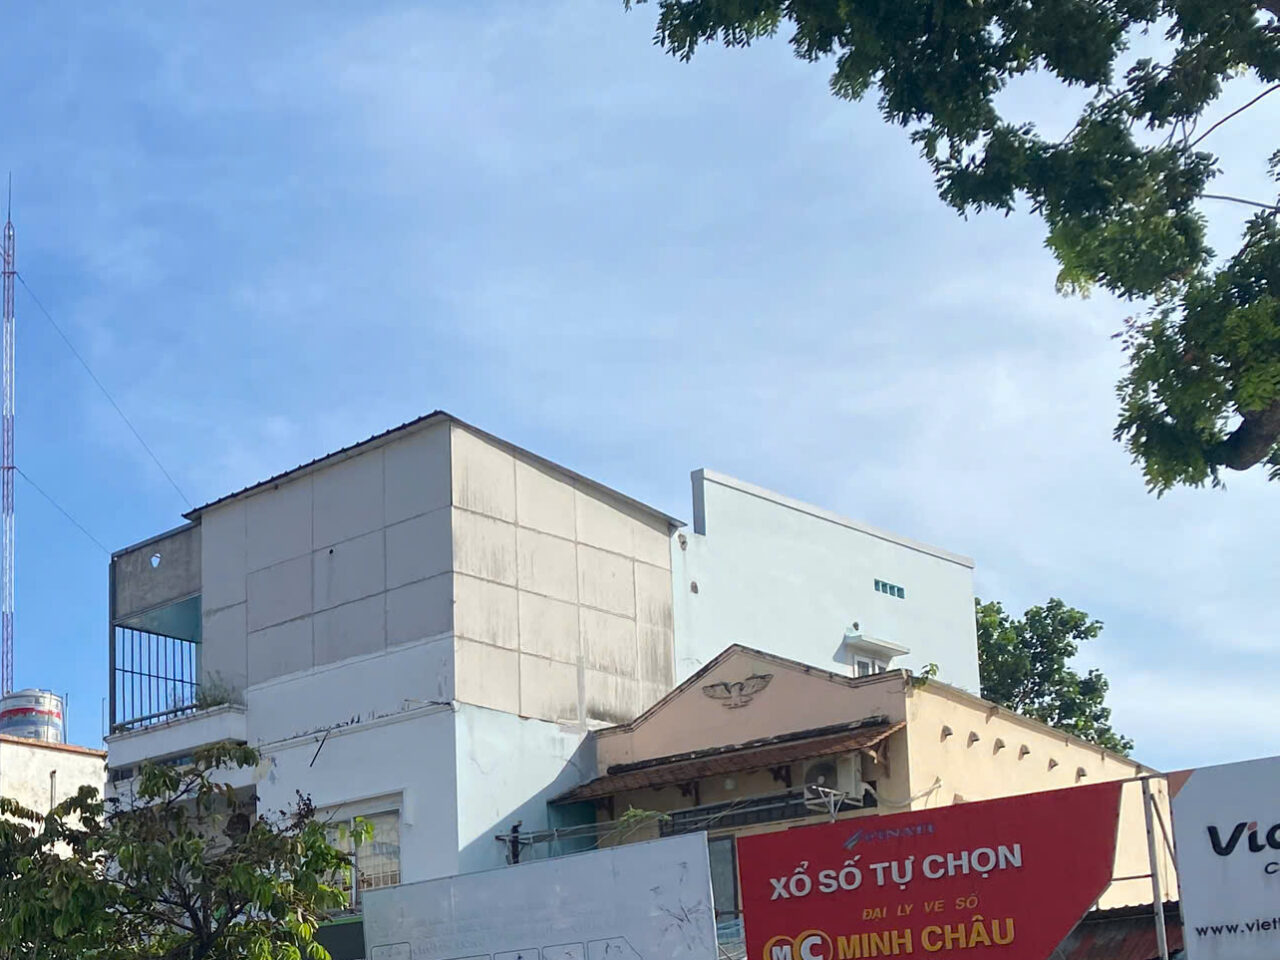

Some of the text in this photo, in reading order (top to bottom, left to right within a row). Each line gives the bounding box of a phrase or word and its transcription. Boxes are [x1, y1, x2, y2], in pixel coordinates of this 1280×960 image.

[770, 843, 1023, 900] XỔ SỐ TỰ CHỌN
[836, 928, 914, 960] MINH
[921, 914, 1016, 952] CHÂU
